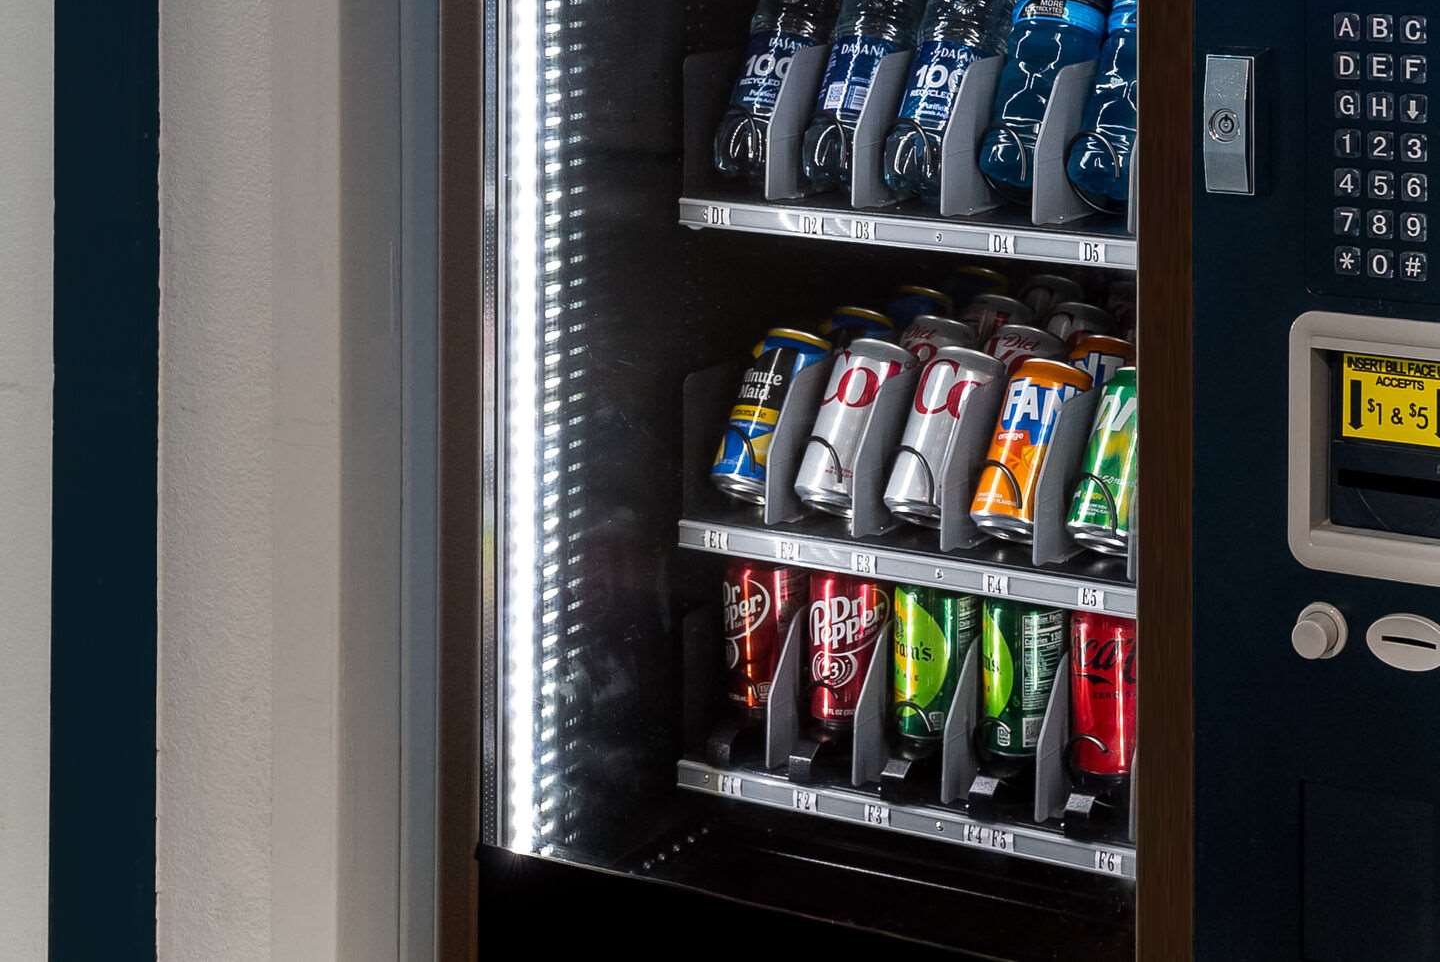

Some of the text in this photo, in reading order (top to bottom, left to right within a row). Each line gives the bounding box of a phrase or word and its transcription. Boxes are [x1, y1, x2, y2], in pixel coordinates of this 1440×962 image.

[1040, 0, 1064, 8] MORE
[1339, 17, 1421, 41] A B C
[1340, 55, 1421, 79] D E F
[1340, 95, 1387, 117] G H
[1341, 134, 1422, 159] 1 2 3
[1339, 173, 1421, 198] 4 5 6
[711, 207, 725, 224] D1
[1340, 212, 1421, 237] 7 8 9
[803, 217, 818, 235] D2
[855, 221, 870, 239] D3
[993, 235, 1009, 254] D4
[1084, 243, 1099, 262] D5
[1372, 254, 1387, 275] 0
[1405, 256, 1422, 277] #
[1347, 356, 1384, 372] INSERT
[1385, 360, 1407, 375] BILL
[1408, 363, 1436, 378] FACE
[744, 368, 783, 386] inute
[1375, 375, 1425, 391] ACCEPTS
[1003, 378, 1079, 425] FAN
[1367, 397, 1429, 430] $1 & $5
[710, 530, 723, 549] E1
[780, 542, 794, 560] E2
[856, 554, 870, 573] E3
[987, 575, 1002, 594] E4
[1082, 588, 1097, 606] E5
[831, 596, 864, 621] Dr
[722, 775, 736, 794] F1
[797, 791, 811, 810] F2
[868, 805, 882, 824] F3
[967, 825, 983, 844] F4
[992, 831, 1007, 849] F5
[1099, 851, 1115, 871] F6
